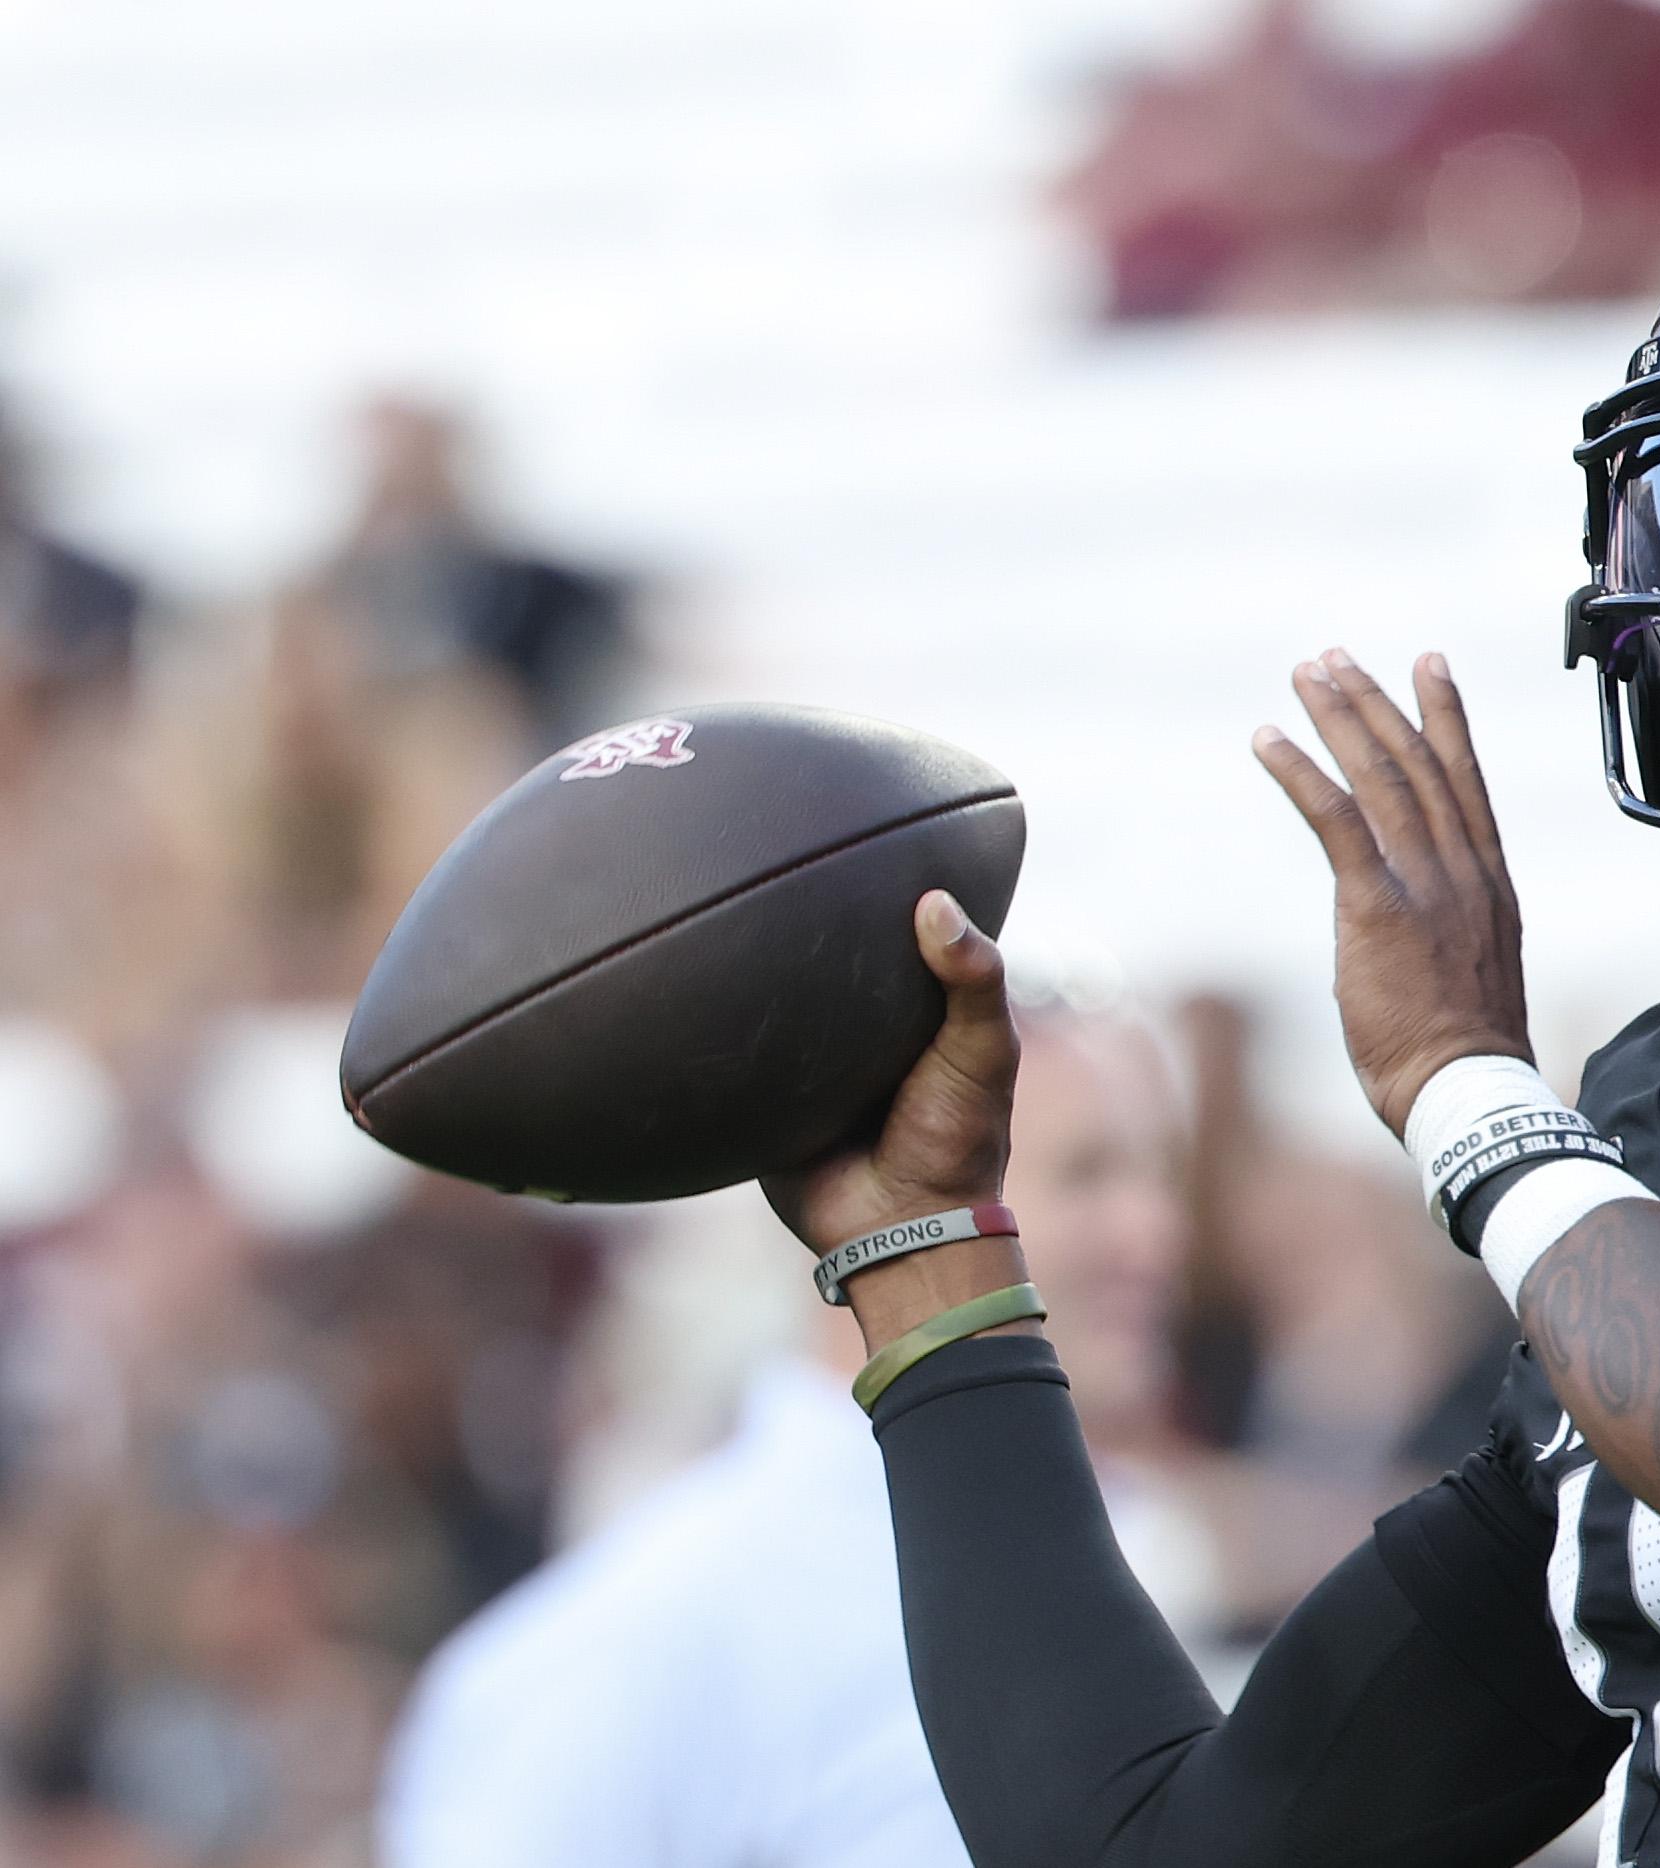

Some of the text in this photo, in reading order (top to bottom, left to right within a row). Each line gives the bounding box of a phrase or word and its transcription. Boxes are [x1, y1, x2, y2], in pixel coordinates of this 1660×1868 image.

[1431, 1131, 1482, 1177] GOOD
[1489, 1111, 1581, 1139] BETTER
[1522, 1132, 1563, 1154] THE
[1563, 1133, 1586, 1151] OF
[1475, 1146, 1521, 1170] 12TH
[845, 1218, 945, 1265] STRONG
